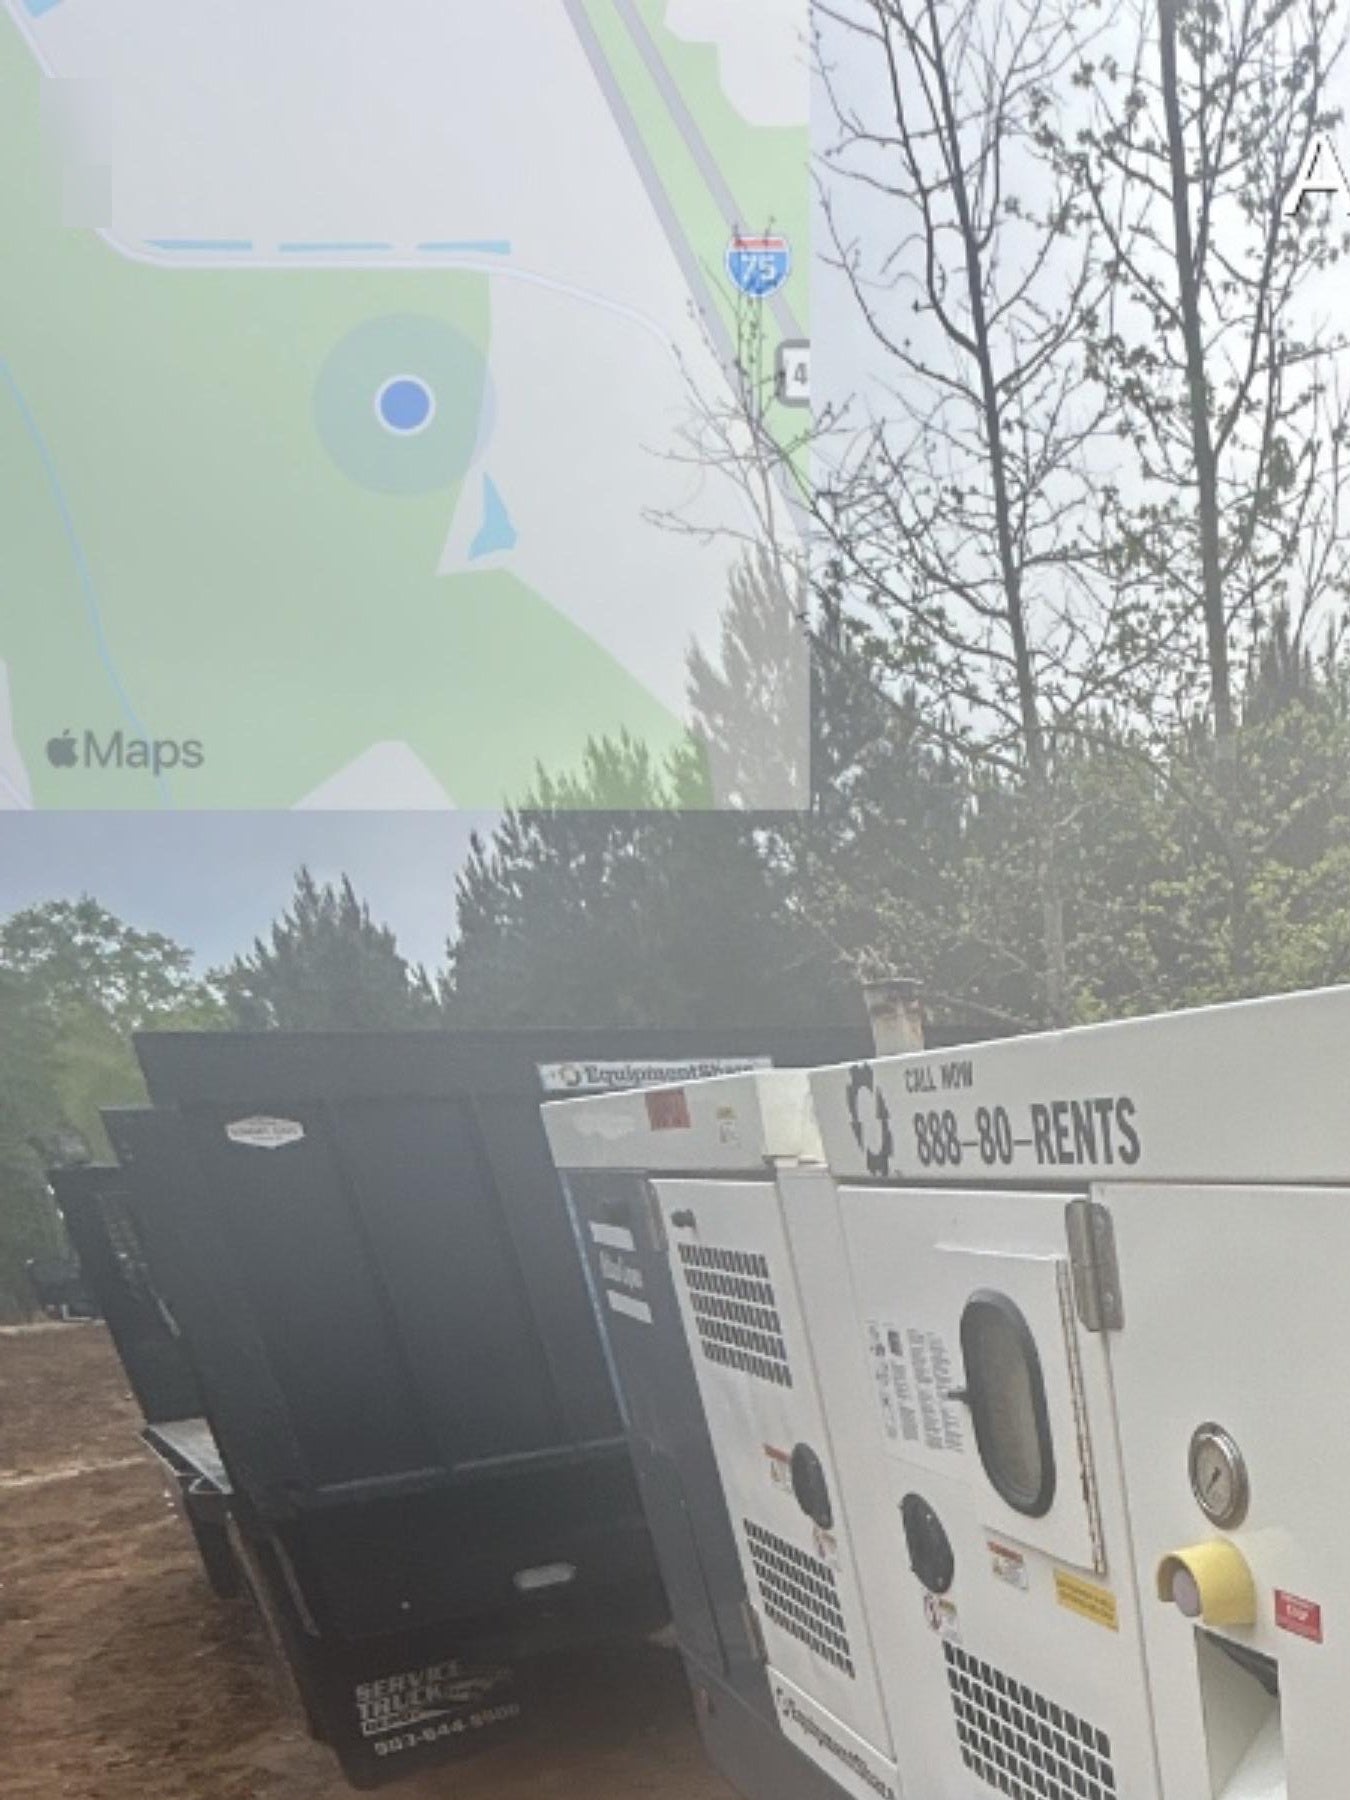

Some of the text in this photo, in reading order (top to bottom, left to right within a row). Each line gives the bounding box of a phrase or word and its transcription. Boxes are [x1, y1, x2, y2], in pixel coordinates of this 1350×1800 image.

[905, 1061, 973, 1093] CALL NOW
[914, 1096, 1140, 1167] 888-80-RENTS
